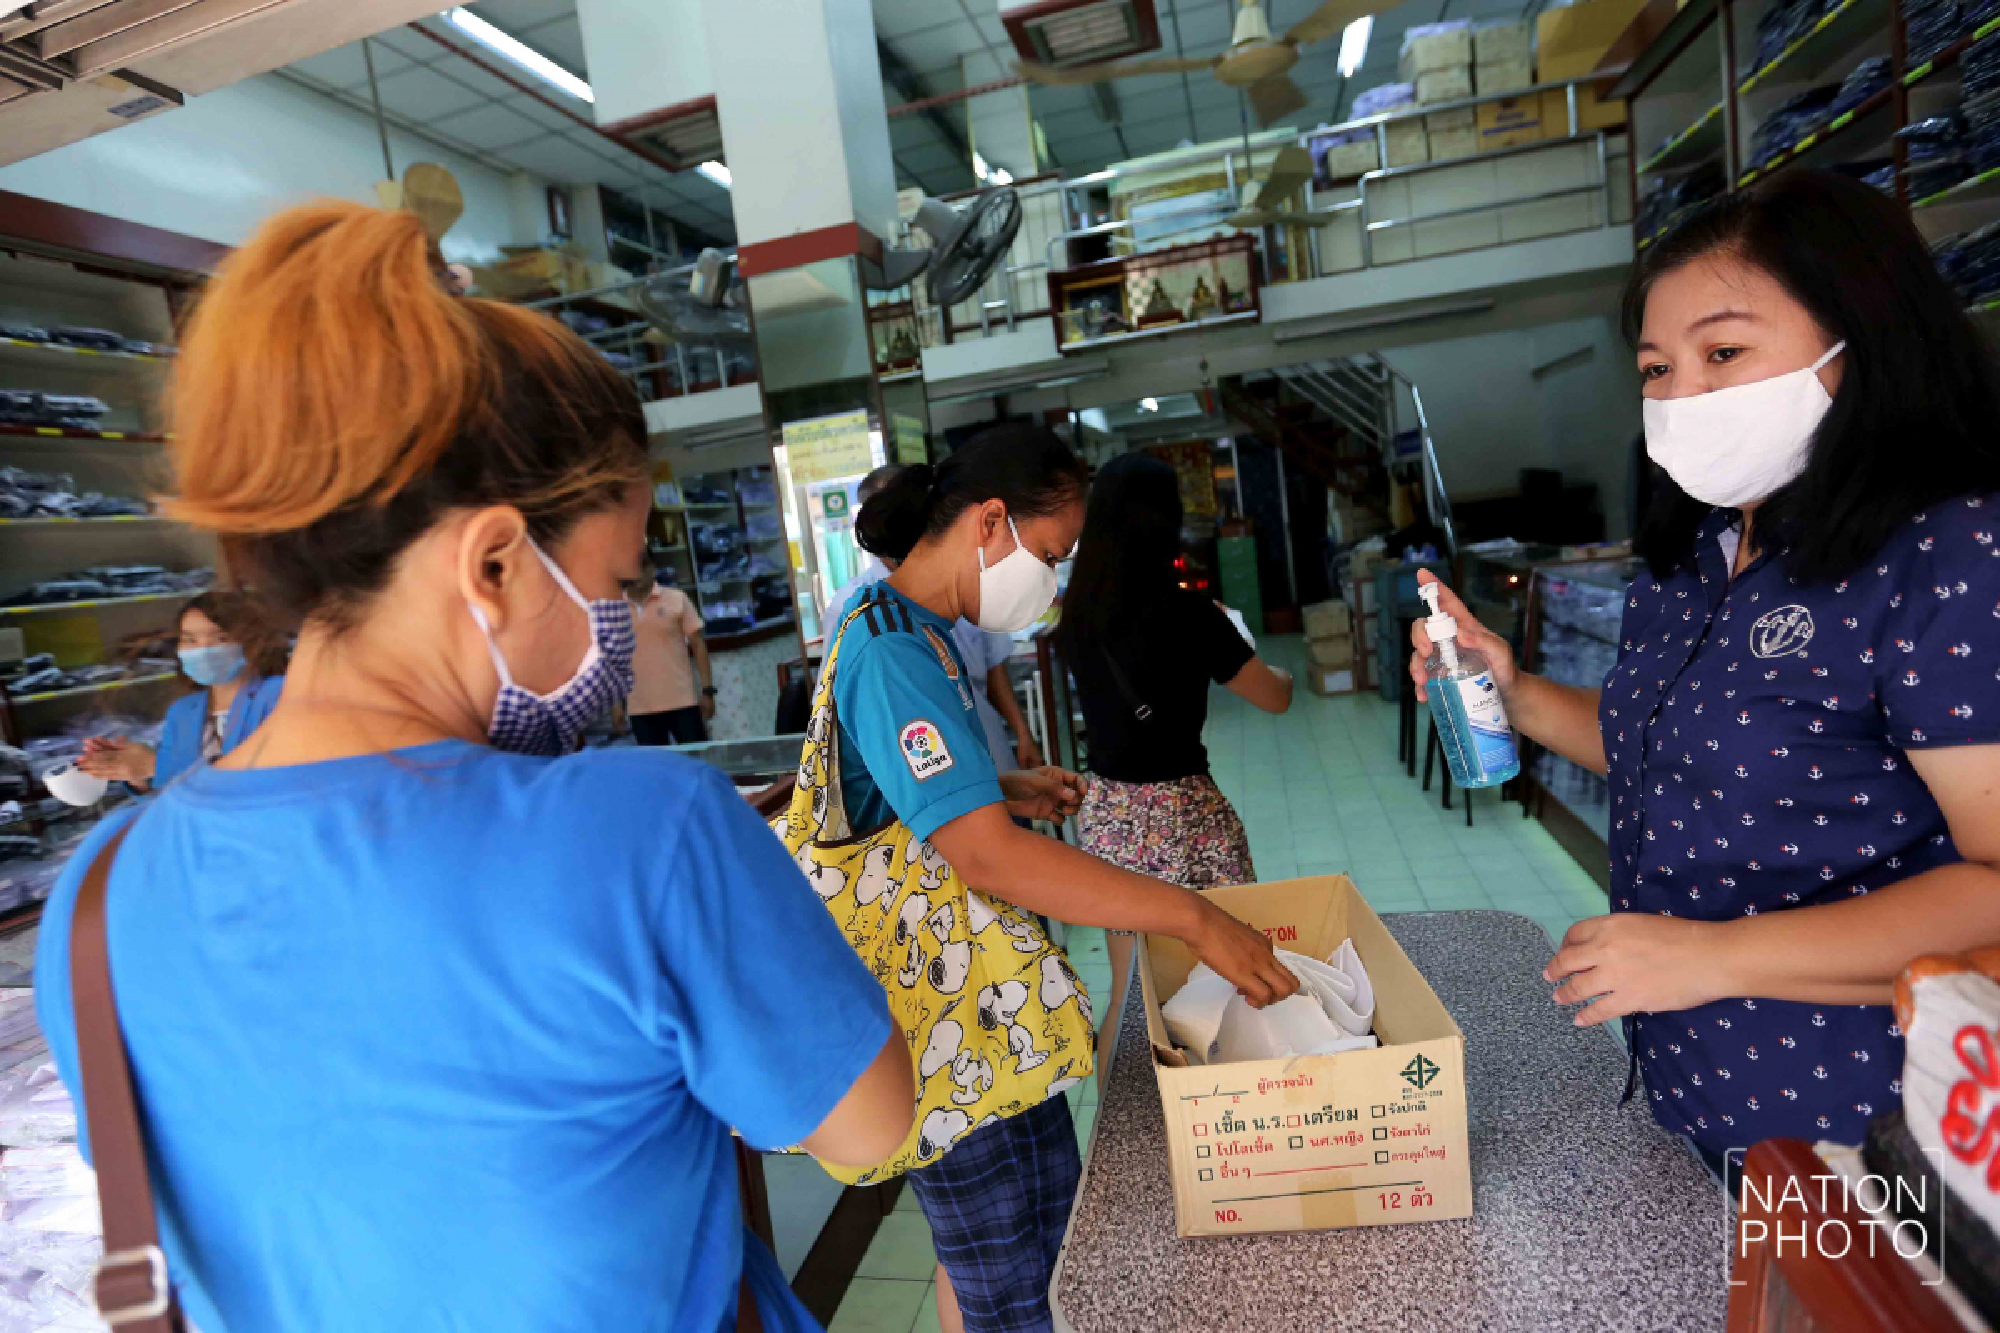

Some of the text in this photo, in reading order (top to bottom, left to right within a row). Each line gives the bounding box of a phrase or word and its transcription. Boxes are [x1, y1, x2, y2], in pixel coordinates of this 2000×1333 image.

[1304, 1104, 1358, 1126] เตรียม
[1378, 1186, 1433, 1210] 12 ตัว
[1215, 1209, 1243, 1224] NO.
